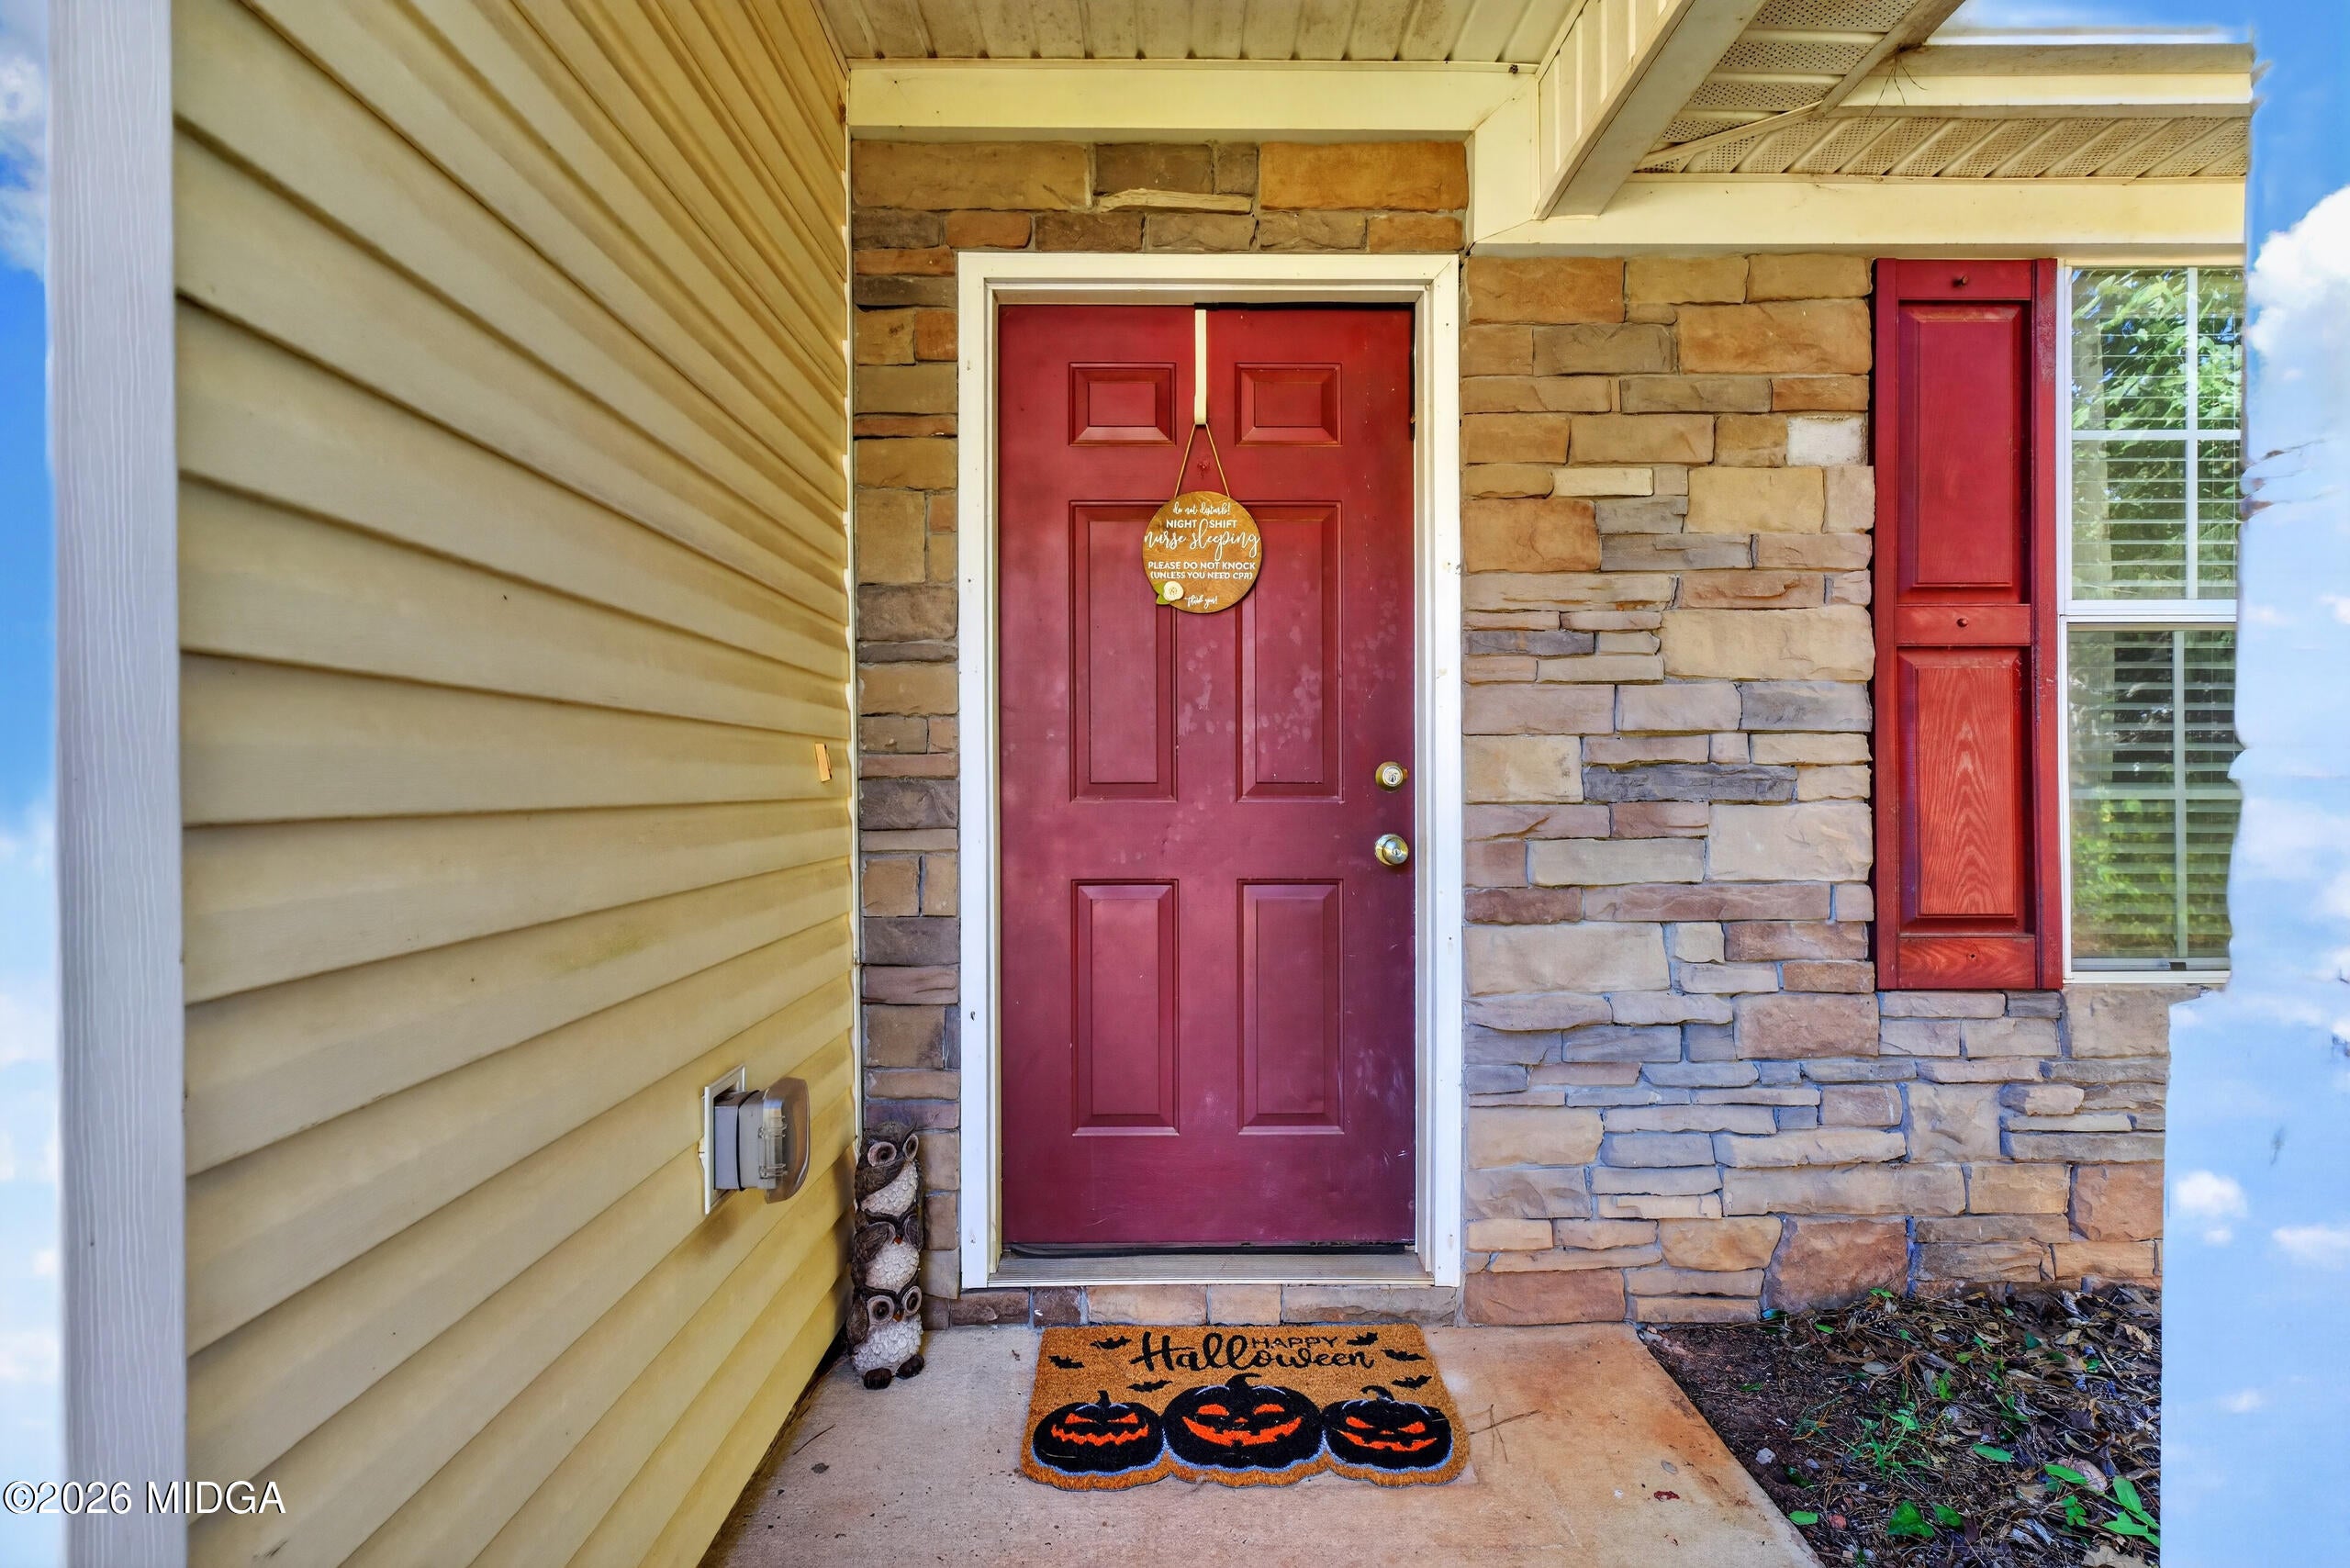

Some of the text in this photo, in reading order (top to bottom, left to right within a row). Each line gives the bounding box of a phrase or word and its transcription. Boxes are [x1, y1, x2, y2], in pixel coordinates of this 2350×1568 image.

[1166, 520, 1237, 529] NIGHT SHIFT
[1144, 519, 1260, 561] nurse sleeping
[1147, 561, 1256, 570] PLEASE DO NOT KNOCK
[1150, 571, 1253, 579] (UNLESS YOU NEED CPR)
[1251, 1336, 1339, 1349] HAPPY
[1129, 1330, 1375, 1372] Halloween
